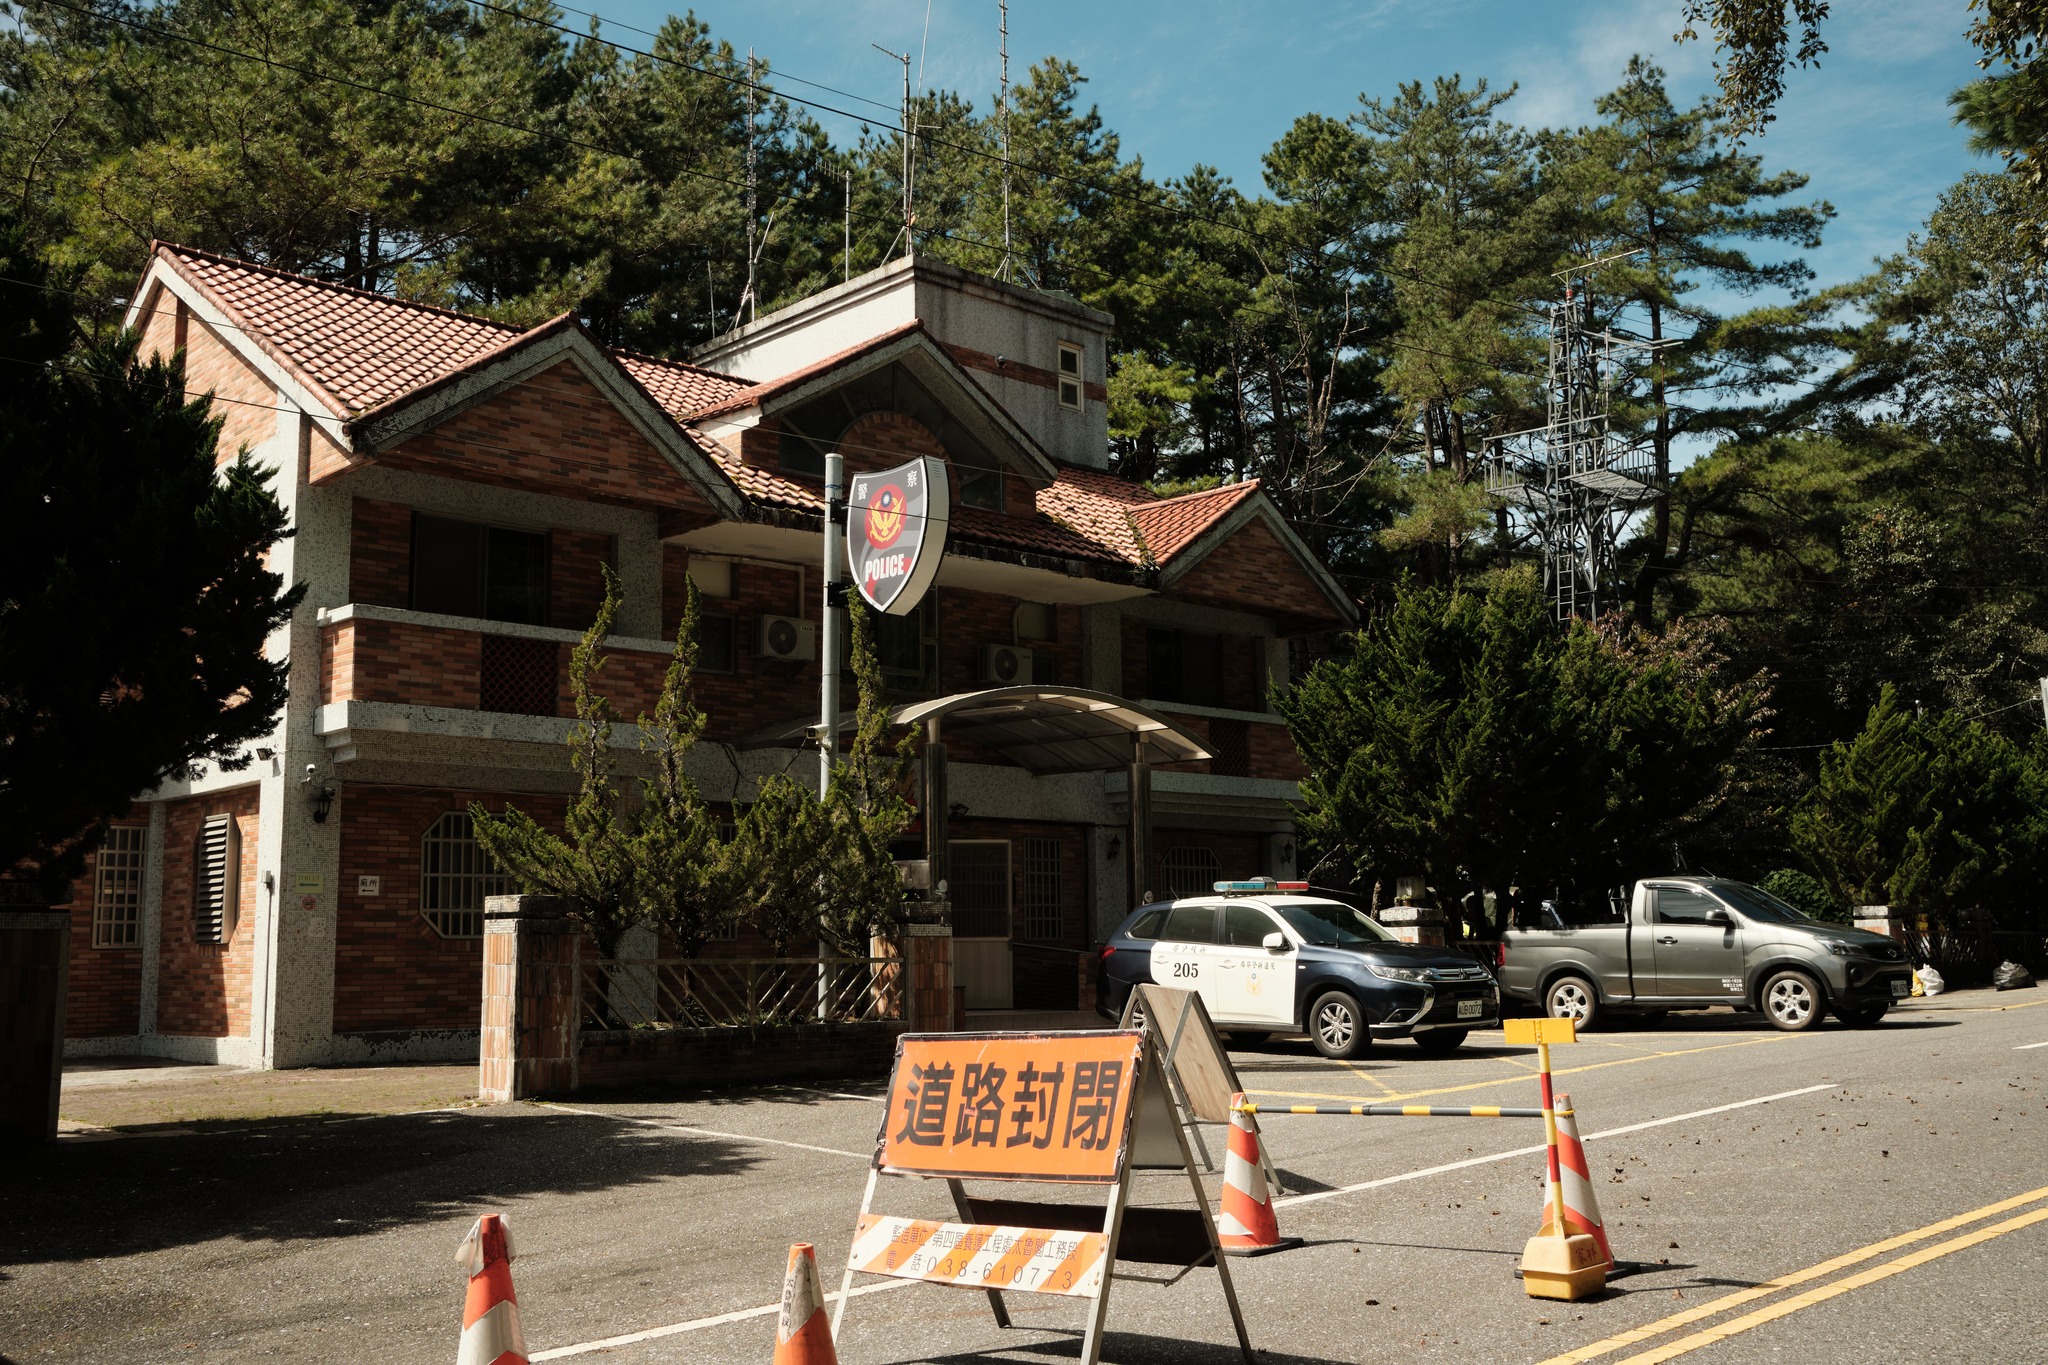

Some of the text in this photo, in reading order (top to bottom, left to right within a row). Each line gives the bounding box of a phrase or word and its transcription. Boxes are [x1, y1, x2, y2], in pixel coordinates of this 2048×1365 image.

[858, 470, 918, 501] 警 察
[864, 553, 905, 583] POLICE
[1173, 962, 1199, 978] 205
[895, 1060, 1124, 1151] 道路封閉
